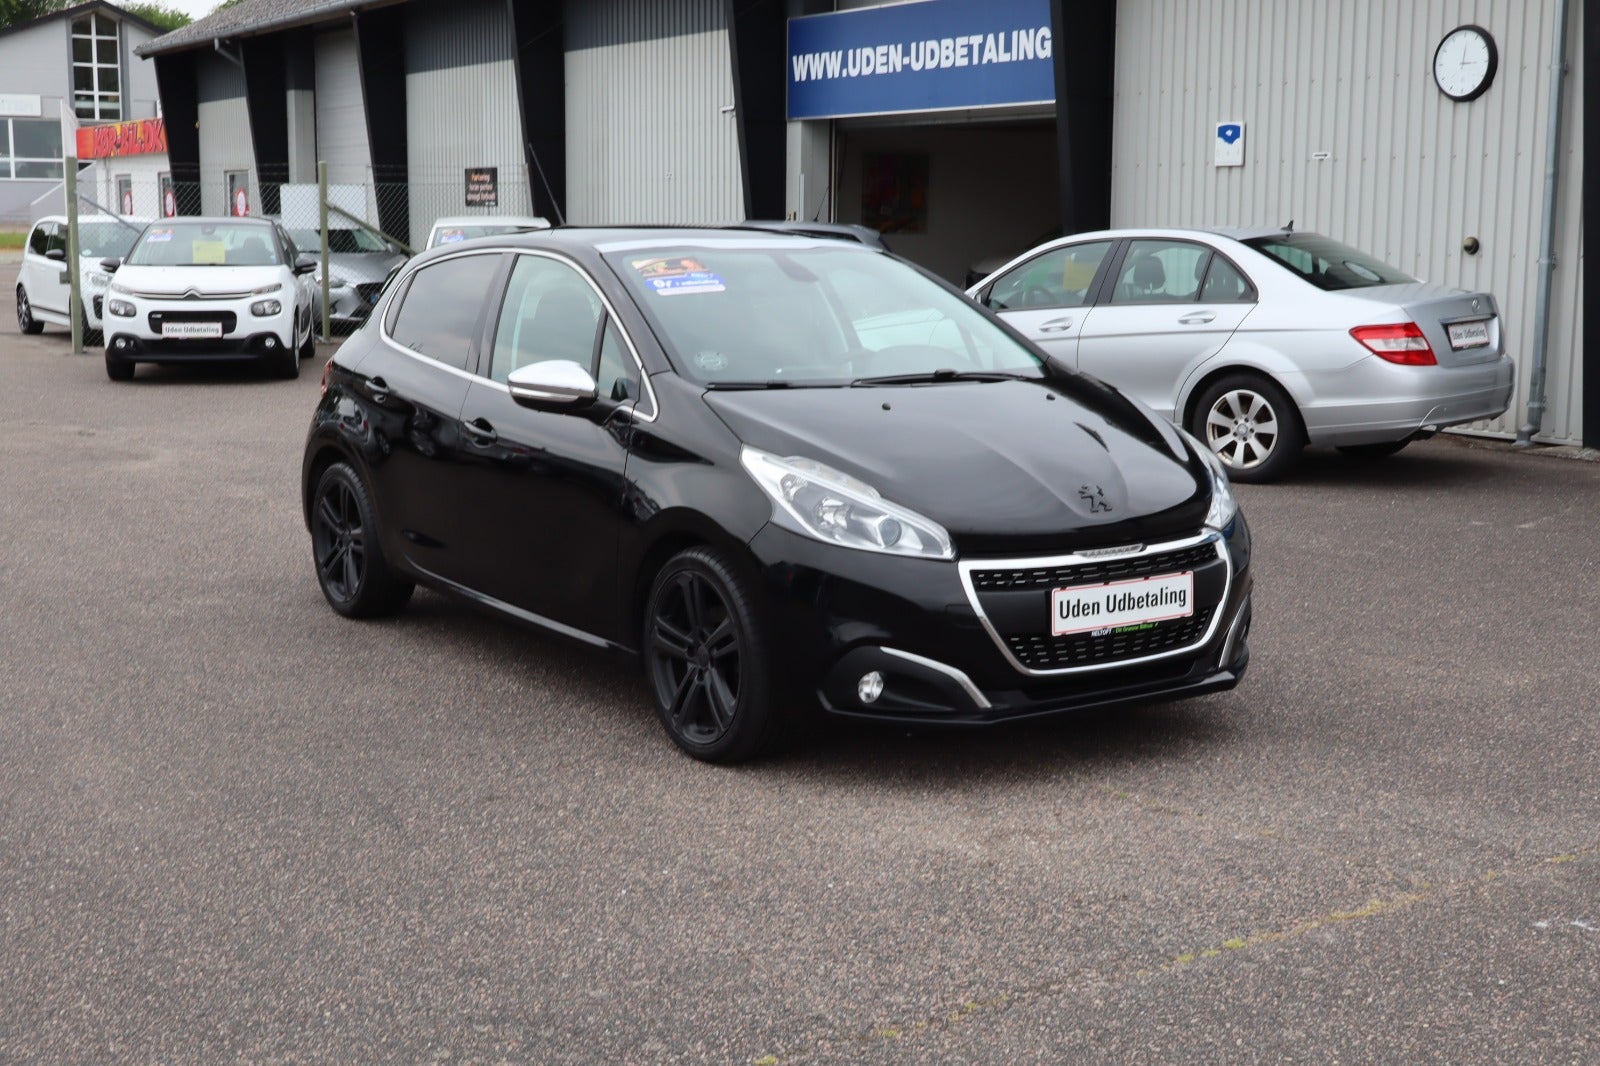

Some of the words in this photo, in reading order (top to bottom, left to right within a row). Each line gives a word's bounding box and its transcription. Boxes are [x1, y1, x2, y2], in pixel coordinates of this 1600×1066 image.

[792, 26, 1052, 82] WWW.UDEN-UDBETALING
[183, 326, 219, 334] Udbetaling
[1059, 598, 1100, 620] Uden
[1106, 586, 1187, 614] Udbetaling
